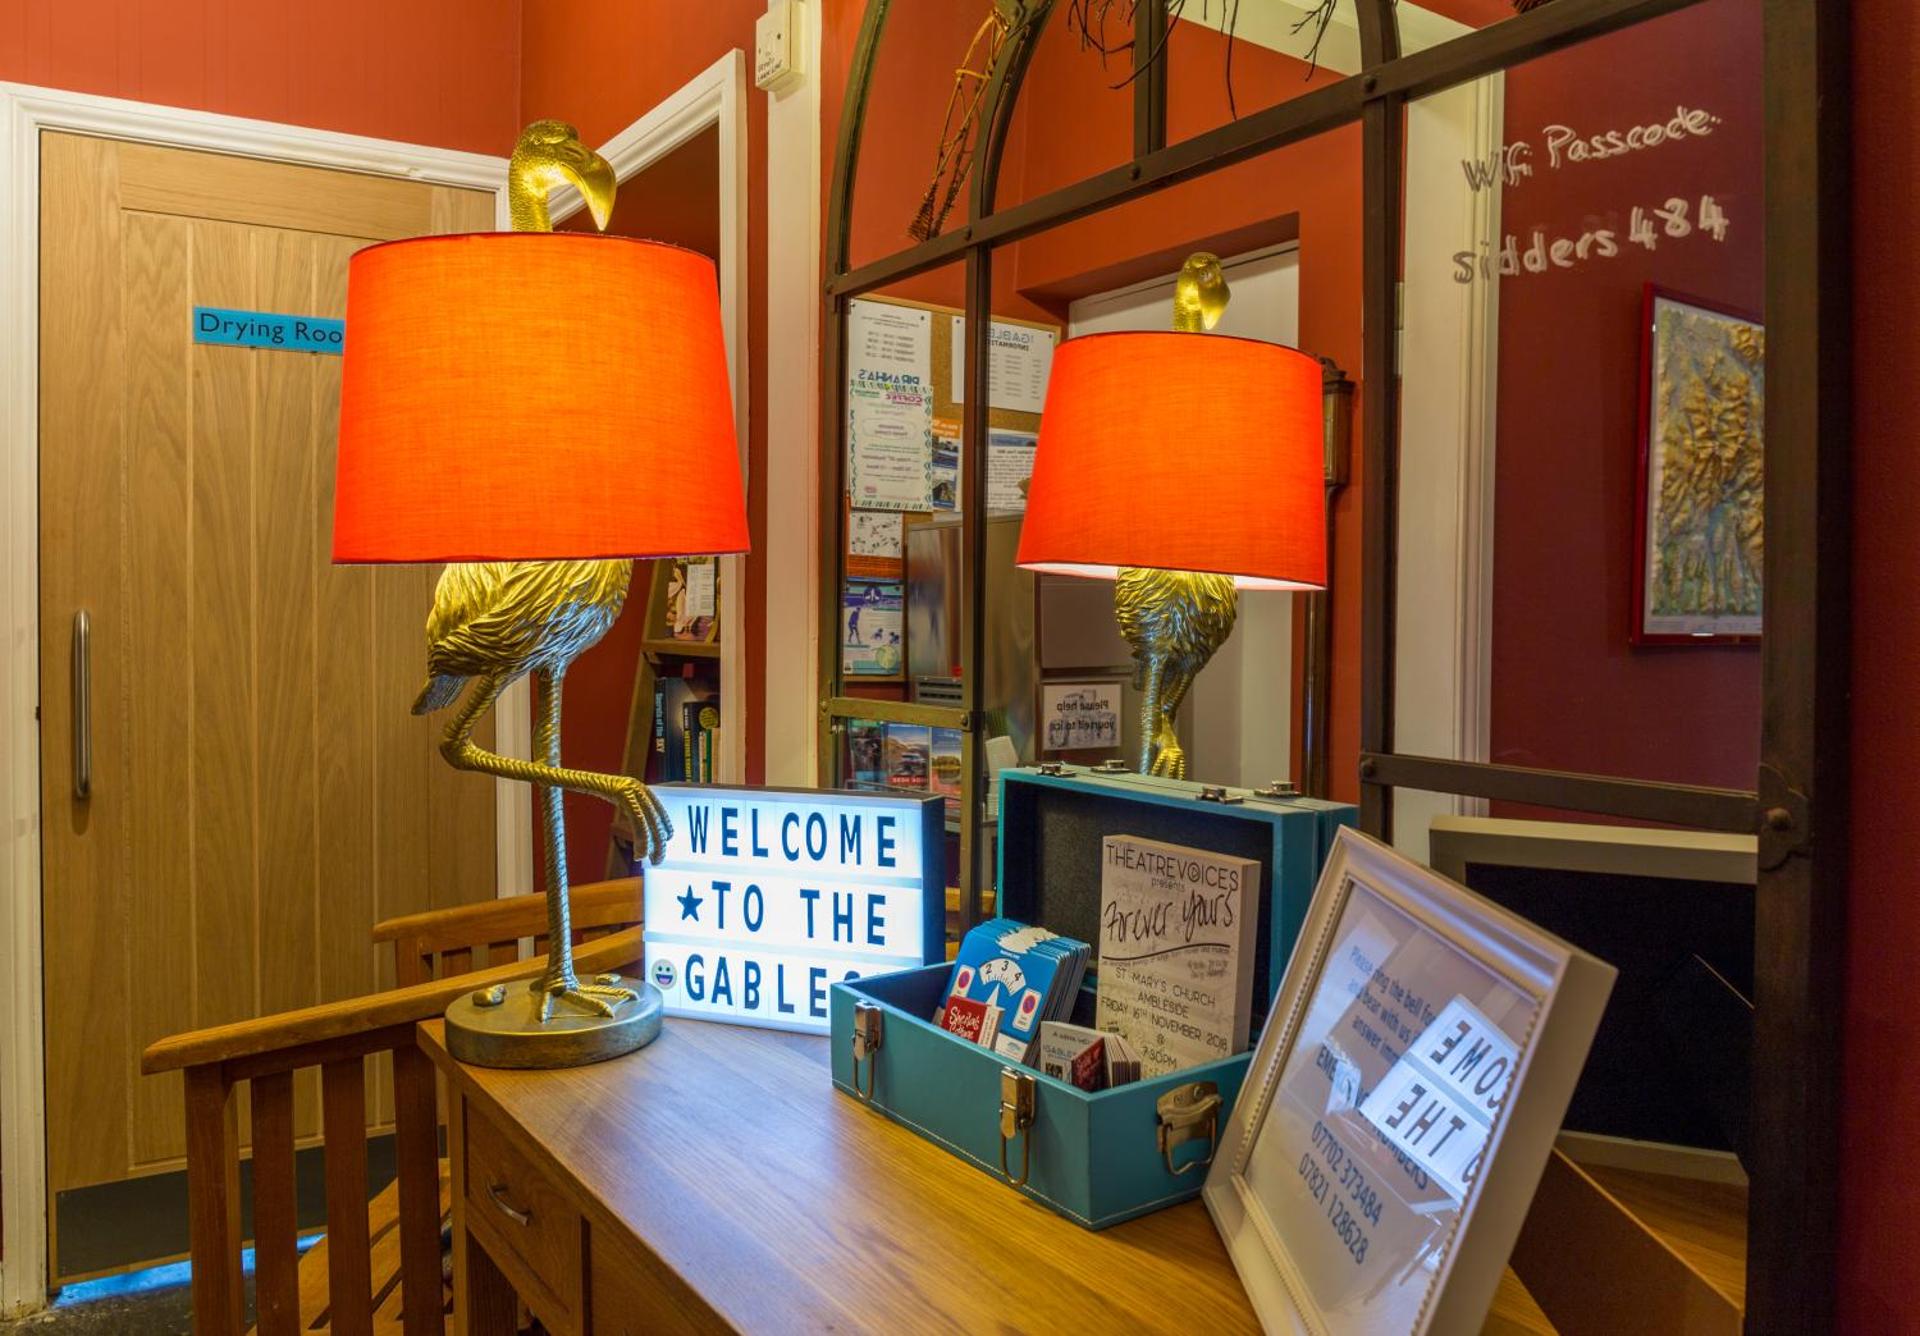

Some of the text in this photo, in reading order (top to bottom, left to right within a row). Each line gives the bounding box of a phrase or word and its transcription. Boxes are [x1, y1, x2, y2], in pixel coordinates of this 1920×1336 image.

[1461, 141, 1533, 192] Wifi
[200, 313, 343, 344] Drying Roo
[687, 804, 897, 868] WELCOME
[1105, 844, 1239, 892] THEATREVOICES
[711, 880, 887, 946] TO THE
[1104, 900, 1174, 943] Forever
[1101, 996, 1129, 1014] FRIDAY
[1151, 1014, 1202, 1041] NOVEMBER
[1138, 991, 1190, 1019] AMBLESIDE
[1172, 984, 1216, 1008] CHURCH
